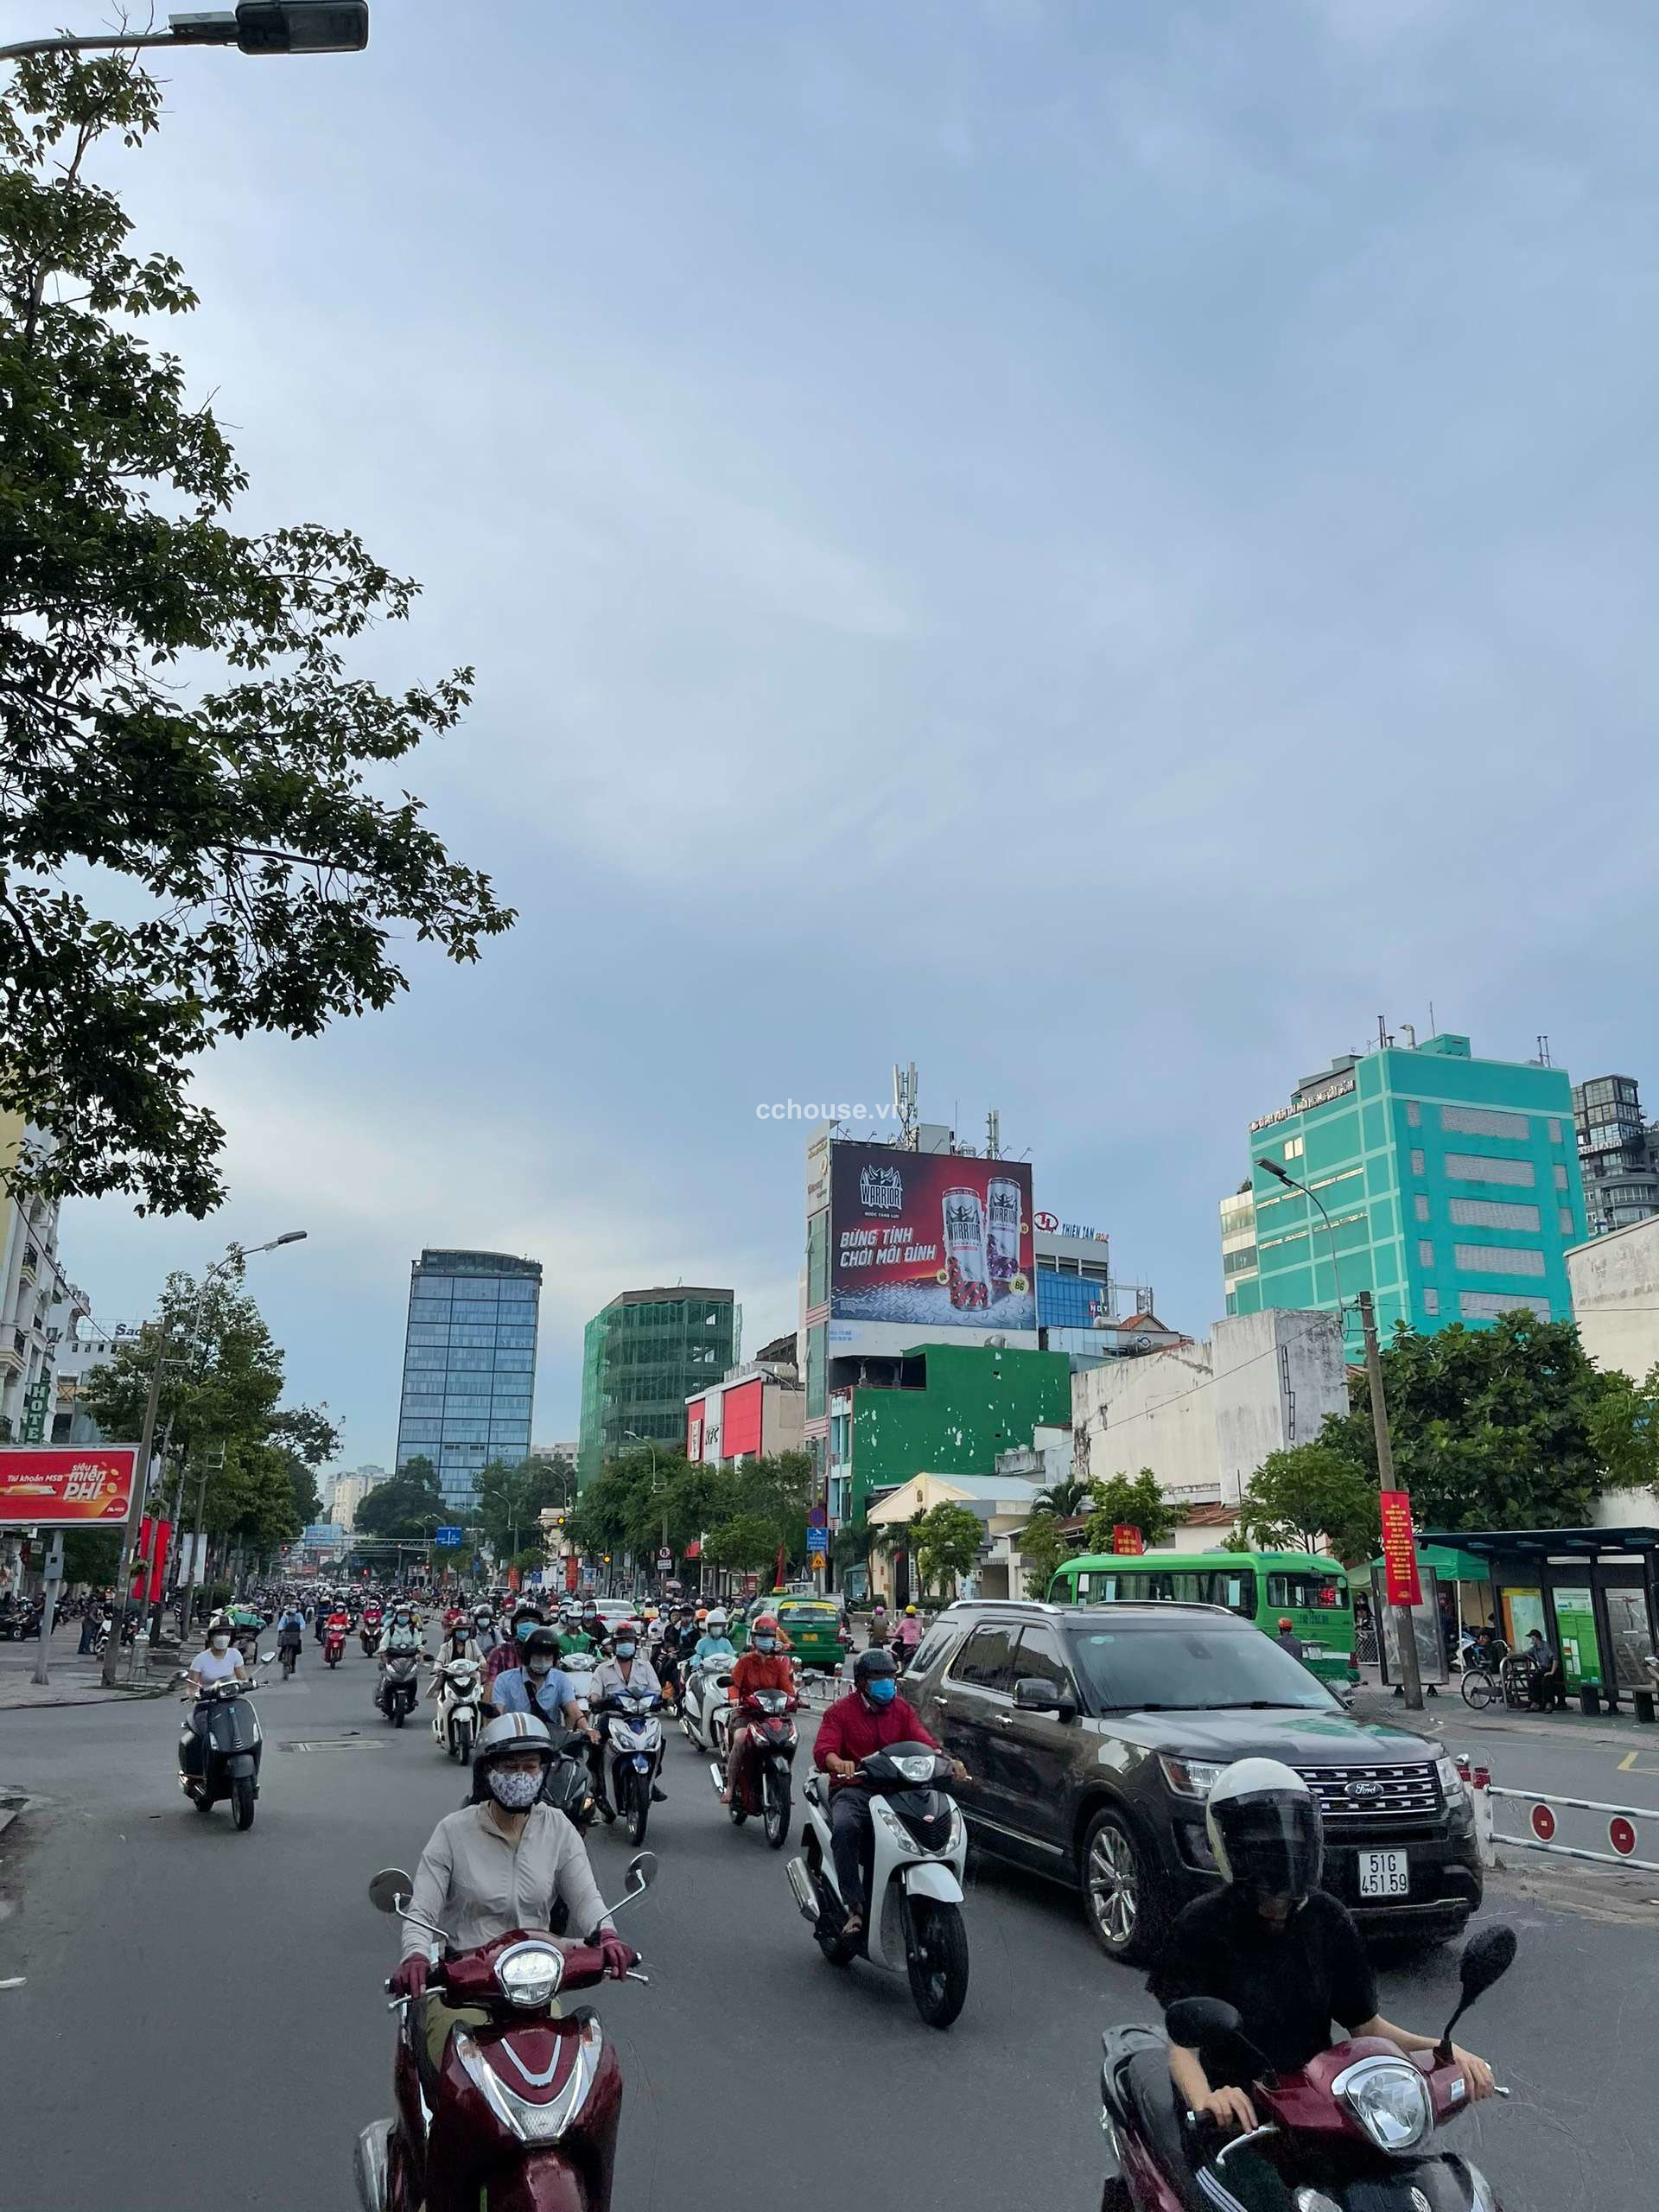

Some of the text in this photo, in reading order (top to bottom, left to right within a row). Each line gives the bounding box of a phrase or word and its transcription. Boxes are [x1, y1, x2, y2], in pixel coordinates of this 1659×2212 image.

[860, 1184, 902, 1210] WARRIOR
[988, 1206, 1017, 1224] WARRIOR
[840, 1225, 913, 1248] BỪNG TỈNH
[947, 1221, 981, 1242] WARRIOR
[1014, 1280, 1025, 1290] B6
[27, 1385, 42, 1444] HOTE
[705, 1427, 720, 1446] KFC
[1355, 1783, 1376, 1795] Ford
[1370, 1854, 1396, 1873] 51G
[1362, 1873, 1408, 1893] 451.59
